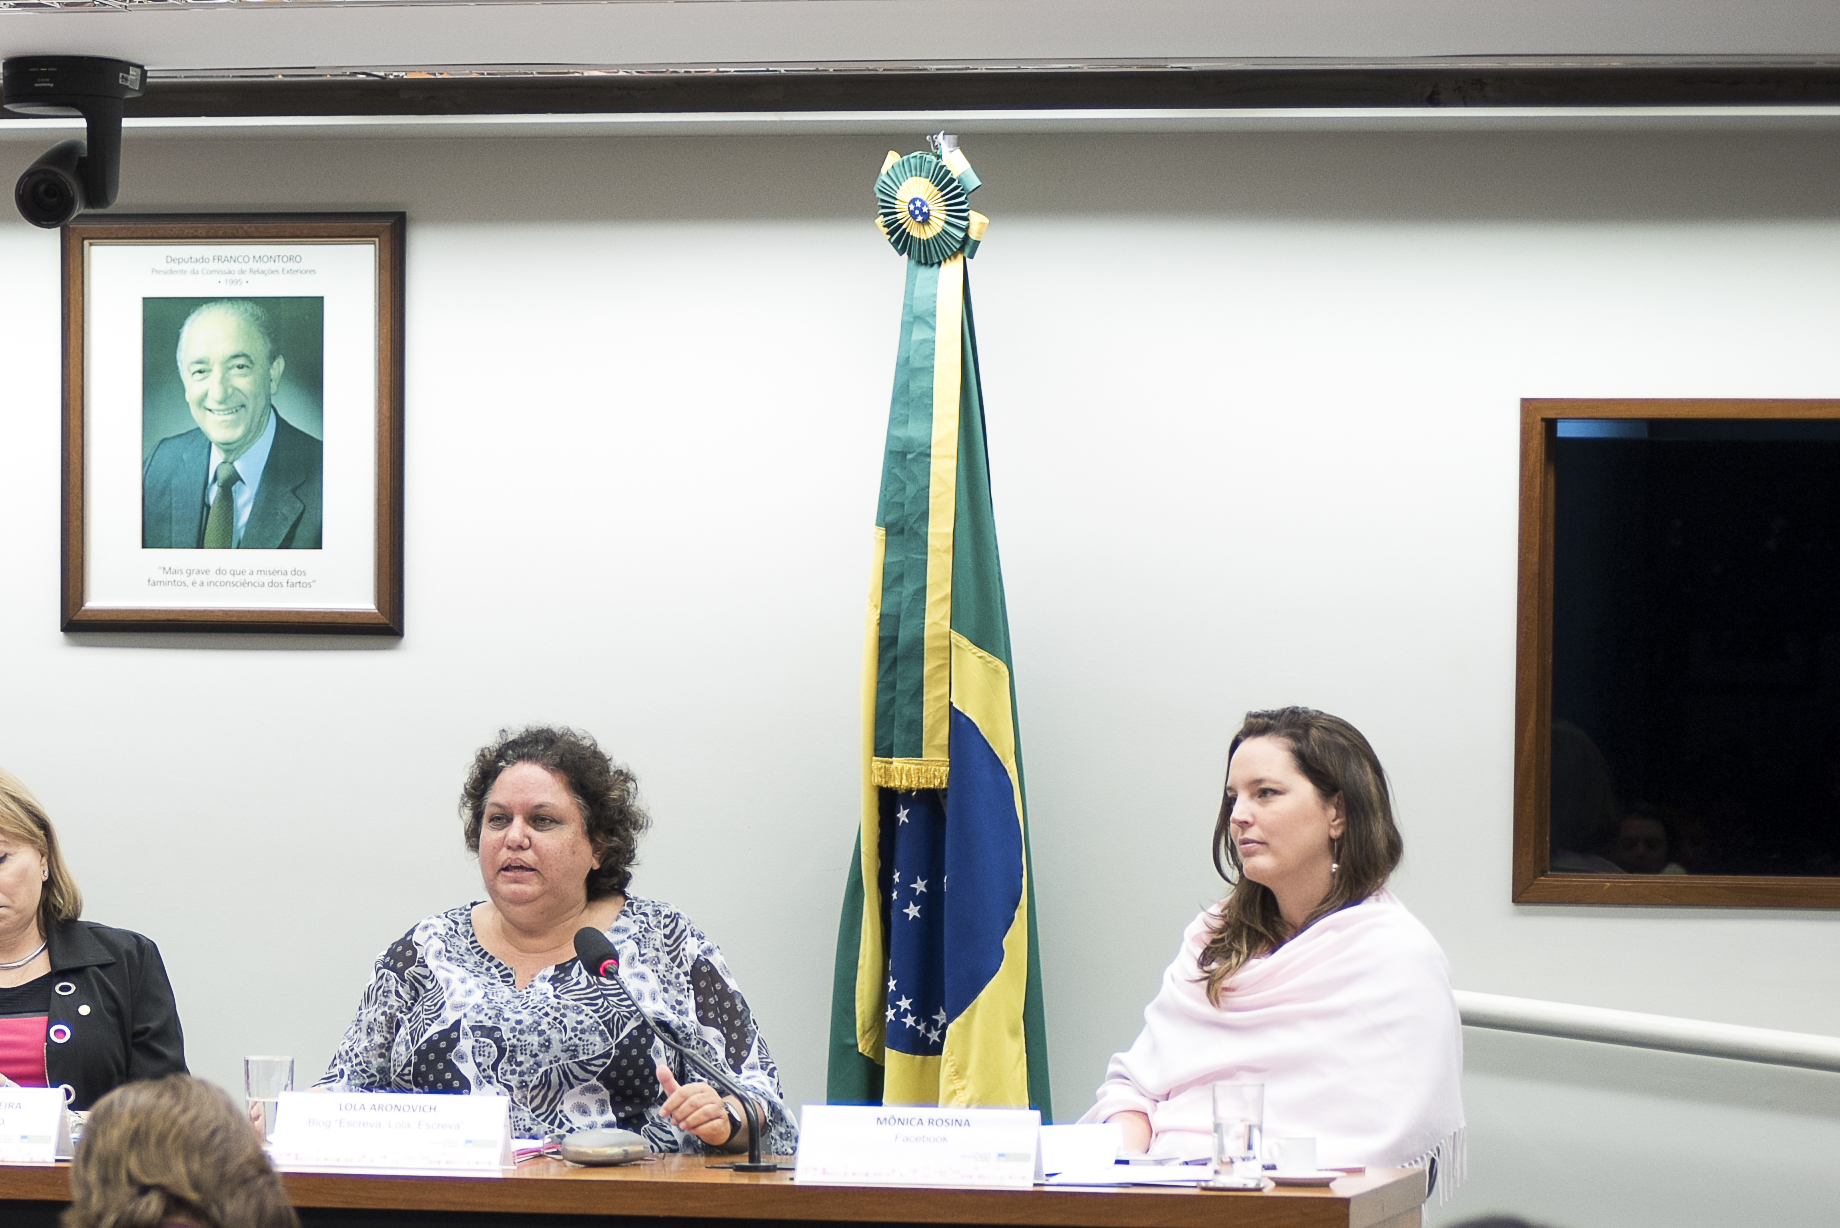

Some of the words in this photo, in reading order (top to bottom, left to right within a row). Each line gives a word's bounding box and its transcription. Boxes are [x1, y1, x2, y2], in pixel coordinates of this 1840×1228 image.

[166, 255, 210, 265] Deputado
[212, 255, 250, 264] FRANCO
[253, 254, 302, 264] MONTORO
[151, 267, 188, 275] Presidente
[190, 267, 199, 275] da
[201, 267, 236, 275] Comissão
[238, 267, 247, 275] de
[249, 267, 280, 276] Relações
[282, 267, 316, 275] Exteriores
[224, 278, 243, 286] 1995
[185, 568, 210, 578] grave
[215, 567, 227, 576] do
[229, 569, 247, 578] que
[256, 567, 288, 577] miséria
[290, 567, 307, 577] dos
[147, 577, 189, 588] famintos,
[191, 578, 197, 587] é
[206, 578, 265, 588] inconsciência
[267, 579, 284, 588] dos
[339, 1103, 366, 1111] LOLA
[369, 1103, 437, 1113] ARONOVICH
[307, 1117, 331, 1130] Blog
[876, 1115, 924, 1127] MÔNICA
[927, 1118, 971, 1128] ROSINA
[894, 1133, 949, 1144] Facebook
